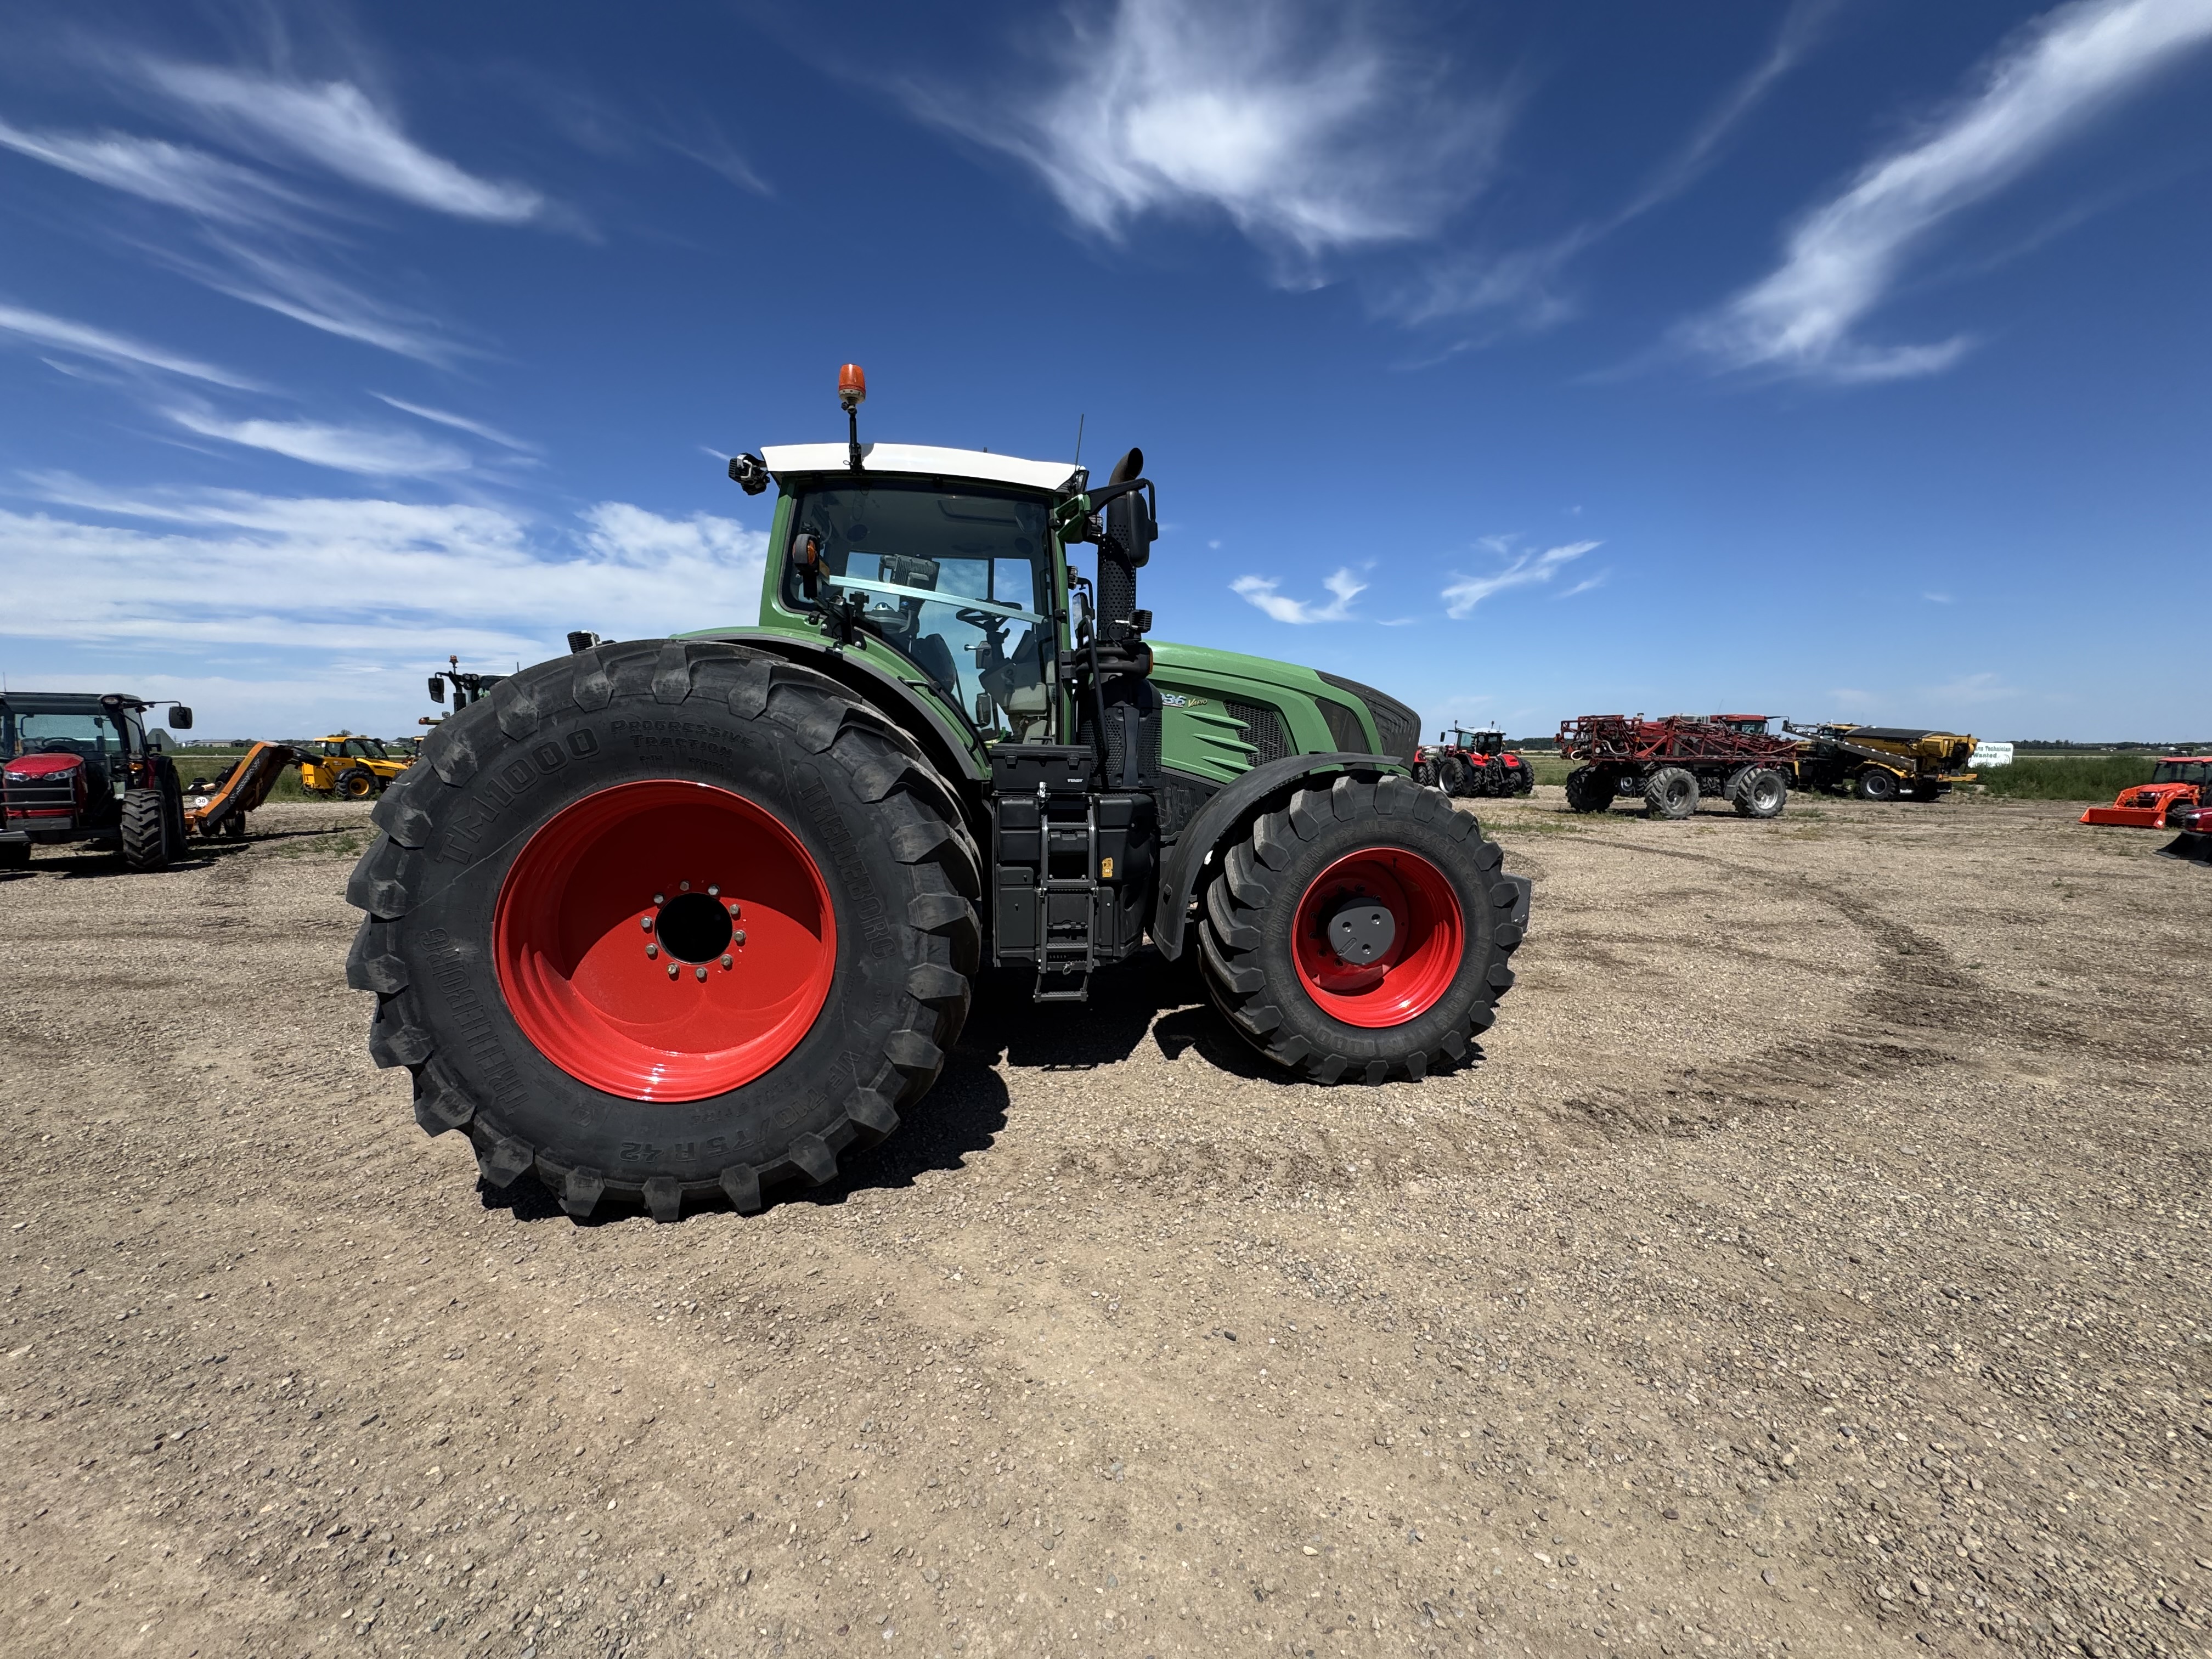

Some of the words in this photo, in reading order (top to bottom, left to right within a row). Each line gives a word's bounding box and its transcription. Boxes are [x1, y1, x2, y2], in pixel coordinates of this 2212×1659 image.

[435, 728, 601, 865] TM1000
[798, 775, 897, 960] TRELLEBORG
[419, 927, 531, 1117] TRELLEBORG
[618, 1140, 664, 1163] 42
